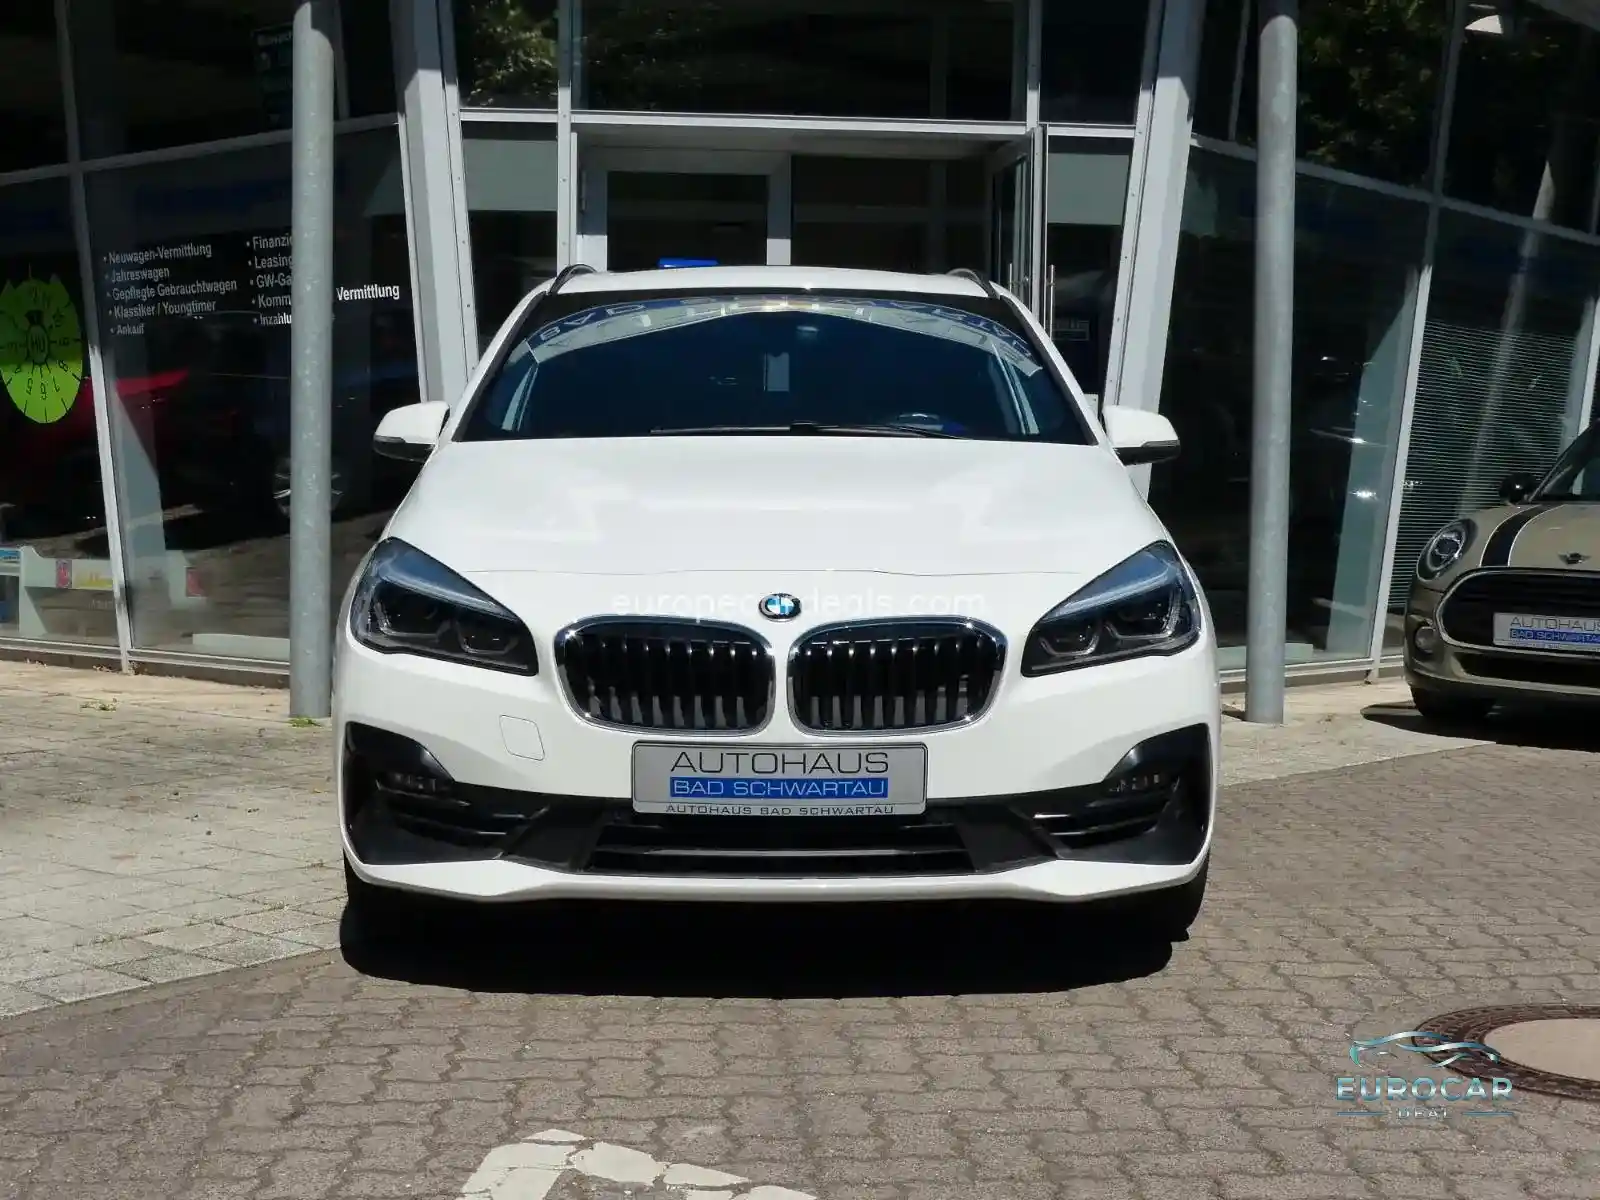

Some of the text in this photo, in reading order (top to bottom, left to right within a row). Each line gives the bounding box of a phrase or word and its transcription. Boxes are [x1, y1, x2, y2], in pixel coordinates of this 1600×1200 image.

[108, 243, 212, 265] Neuwagen-Vermittlung
[111, 267, 170, 283] Jahreswagen
[256, 272, 292, 288] GW-Ga
[112, 279, 237, 303] Gepflegte Gebrauchtwagen
[258, 283, 400, 308] Komm Vermittlung
[113, 304, 155, 319] Klassiker
[161, 300, 216, 317] Youngtimer
[260, 312, 292, 326] Inzahlu
[116, 323, 145, 336] Ankauf
[671, 751, 889, 774] AUTOHAUS
[673, 780, 886, 796] BAD SCHWARTAU
[666, 803, 895, 816] AUTOHAUS BAD SCHWARTAU
